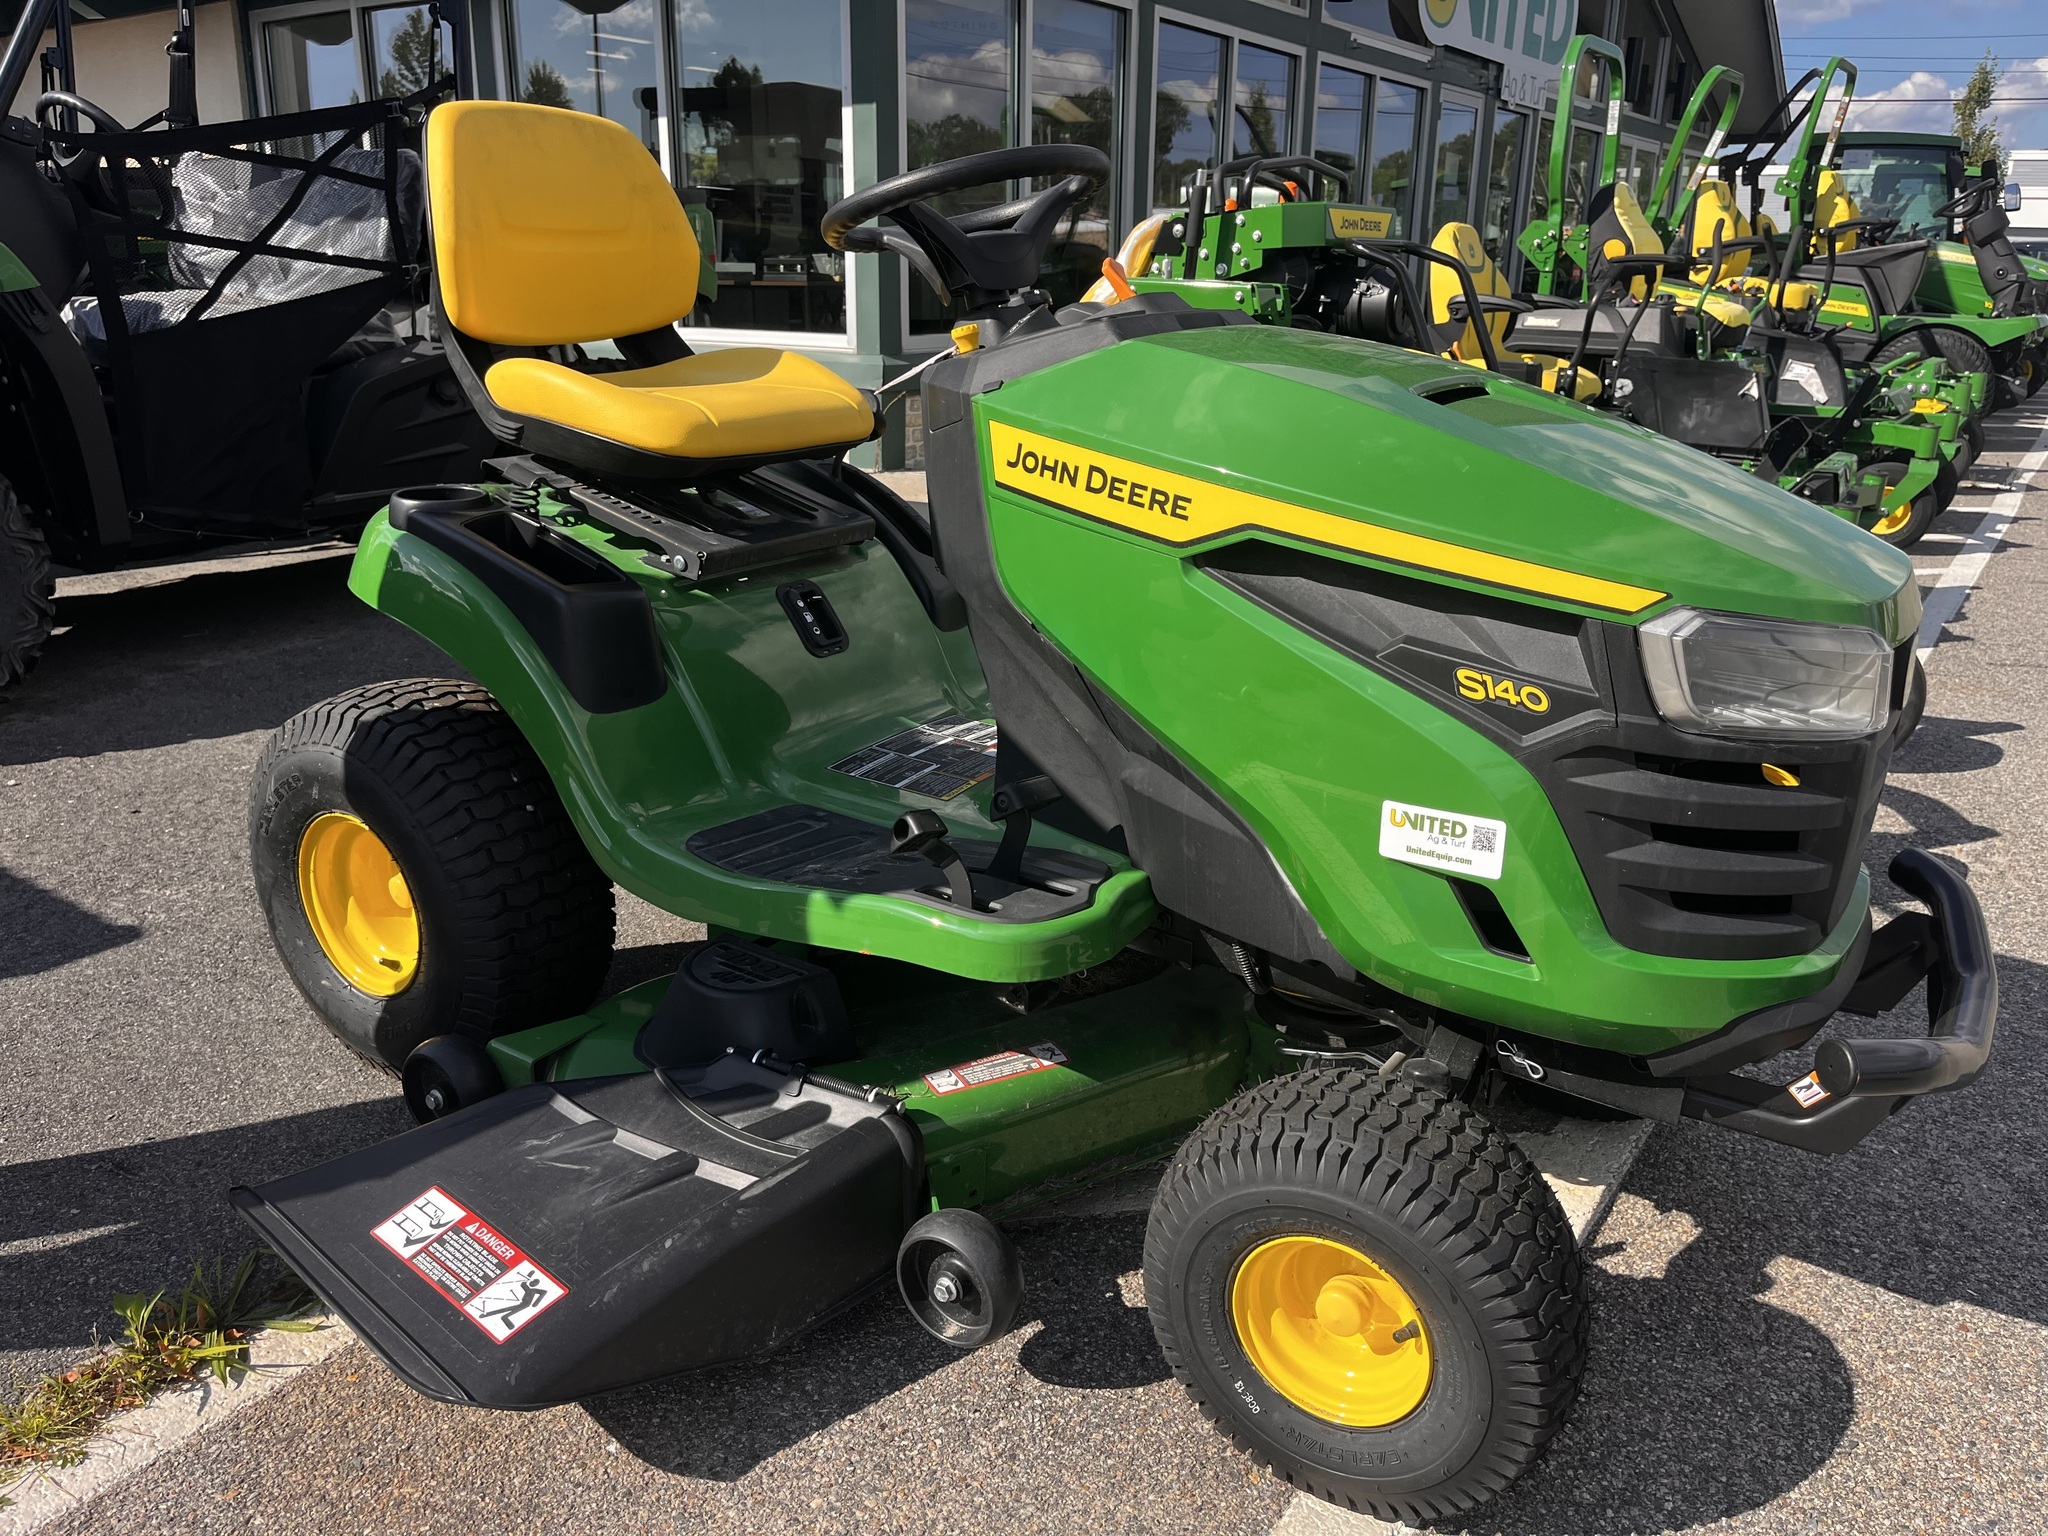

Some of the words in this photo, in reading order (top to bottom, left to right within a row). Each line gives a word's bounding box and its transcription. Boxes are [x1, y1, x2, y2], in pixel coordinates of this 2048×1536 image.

[1503, 69, 1517, 104] Ag
[1519, 73, 1526, 101] &
[1340, 216, 1359, 231] JOHN
[1360, 217, 1382, 232] DEERE
[1006, 443, 1079, 488] JOHN
[1085, 464, 1193, 521] DEERE
[1456, 668, 1549, 713] S140
[1390, 808, 1468, 839] UNITED
[1406, 845, 1472, 865] UnitedEquip.com
[1427, 834, 1439, 845] Ag
[1441, 837, 1448, 845] &
[1450, 838, 1467, 848] Turf
[977, 1052, 1011, 1064] DANGER
[443, 1242, 465, 1260] THROWN
[461, 1258, 485, 1277] OBJECTS
[460, 1232, 484, 1252] ROTATING
[481, 1249, 499, 1265] BLADE
[475, 1228, 515, 1260] DANGER
[1285, 1426, 1402, 1467] CARLSTAR
